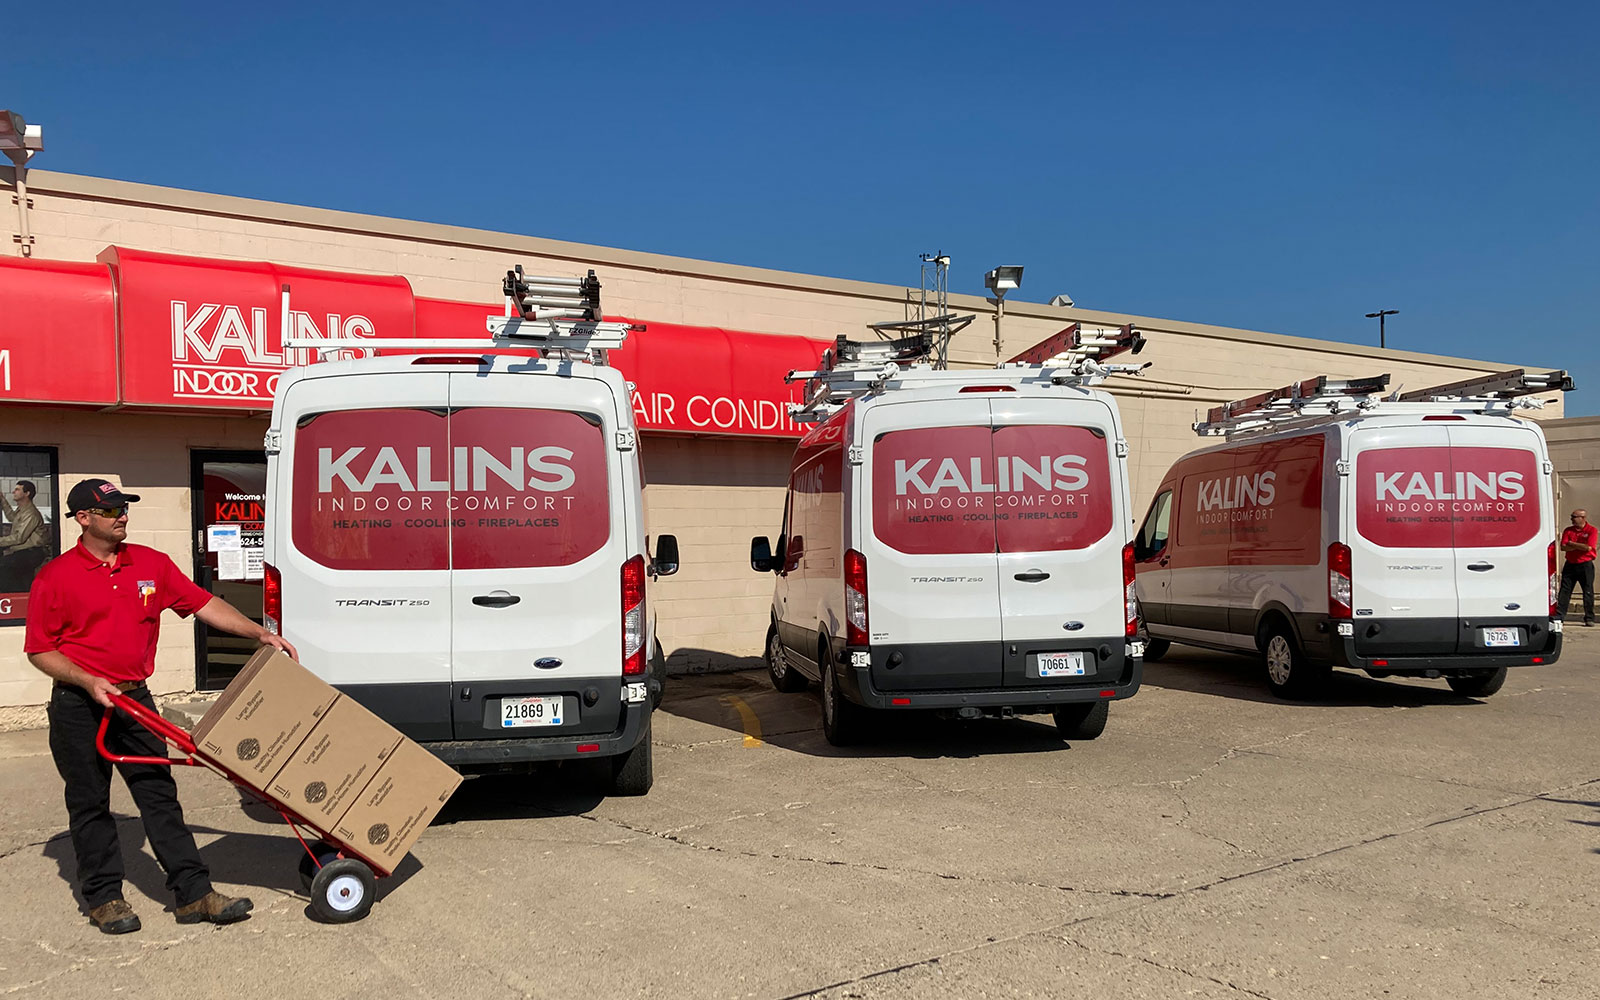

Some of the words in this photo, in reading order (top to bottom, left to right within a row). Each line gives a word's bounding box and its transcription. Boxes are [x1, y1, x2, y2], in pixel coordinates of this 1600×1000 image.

[170, 300, 375, 367] KALINS
[173, 369, 258, 396] INDOOR
[632, 391, 675, 425] AIR
[687, 395, 813, 432] CONDIT
[318, 446, 576, 493] KALINS
[894, 454, 1090, 495] KALINS
[1197, 470, 1276, 512] KALINS
[1375, 471, 1525, 501] KALINS
[224, 493, 261, 501] Welcome
[317, 497, 432, 512] INDOOR
[446, 496, 575, 511] COMFORT
[895, 495, 984, 510] INDOOR
[993, 493, 1090, 507] COMFORT
[215, 502, 265, 520] KALIN
[1375, 502, 1445, 513] INDOOR
[1451, 502, 1525, 512] COMFORT
[333, 519, 392, 529] HEATING
[404, 518, 466, 528] COOLING
[478, 518, 560, 528] FIREPLACES
[908, 514, 954, 523] HEATING
[962, 513, 1009, 521] COOLING
[1018, 511, 1078, 520] FIREPLACES
[1196, 512, 1228, 525] INDOOR
[1231, 508, 1274, 522] COMFORT
[1470, 515, 1517, 523] FIREPLACES
[240, 537, 264, 546] 624-5
[335, 599, 408, 607] TRANSIT
[408, 599, 430, 607] 250
[1486, 631, 1508, 641] 76726
[1511, 631, 1517, 640] V
[1041, 658, 1070, 670] 70661
[1075, 658, 1081, 669] V
[505, 703, 543, 719] 21869
[552, 703, 559, 717] V
